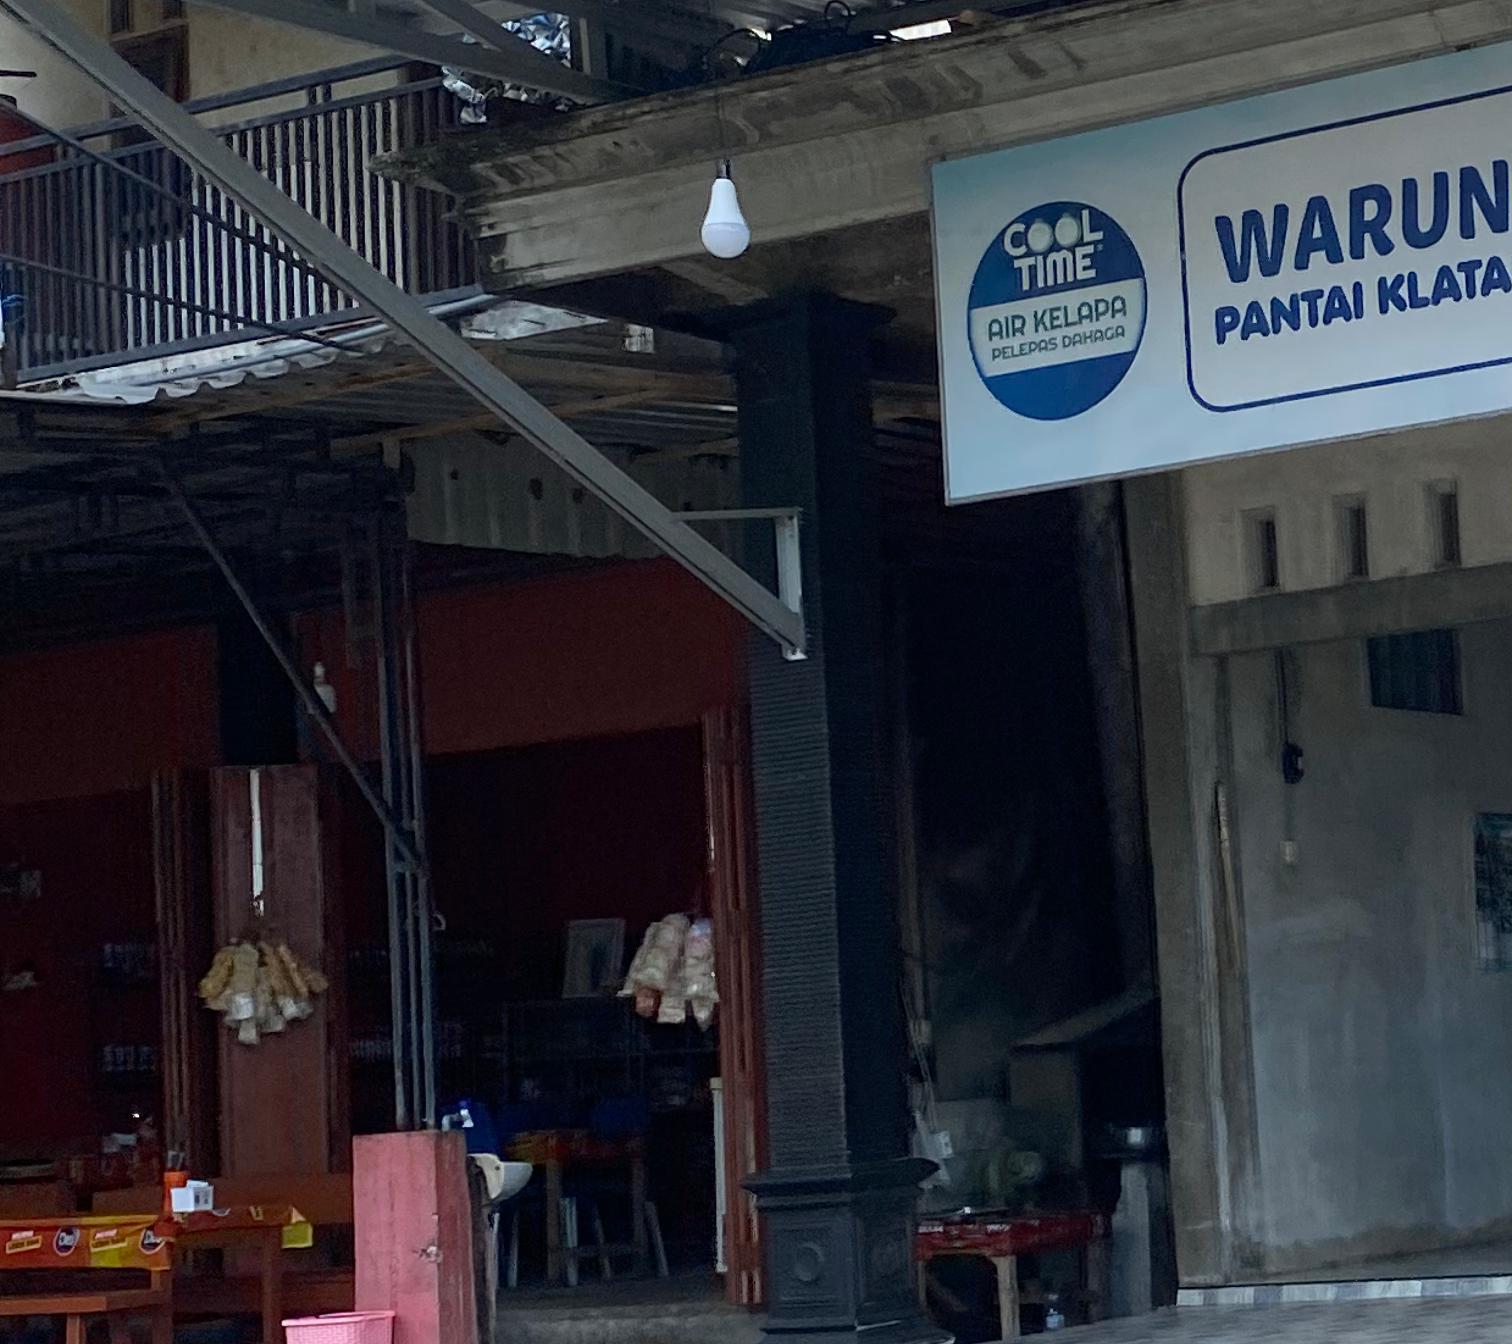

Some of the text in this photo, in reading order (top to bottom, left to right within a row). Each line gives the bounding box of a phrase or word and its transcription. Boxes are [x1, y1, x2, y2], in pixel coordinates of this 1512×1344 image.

[1004, 209, 1103, 256] COOL
[1014, 245, 1096, 291] TIME
[988, 296, 1127, 341] AIR KELAPA
[1215, 281, 1363, 345] PANTAI
[992, 325, 1125, 361] PELEPAS DAHAGA
